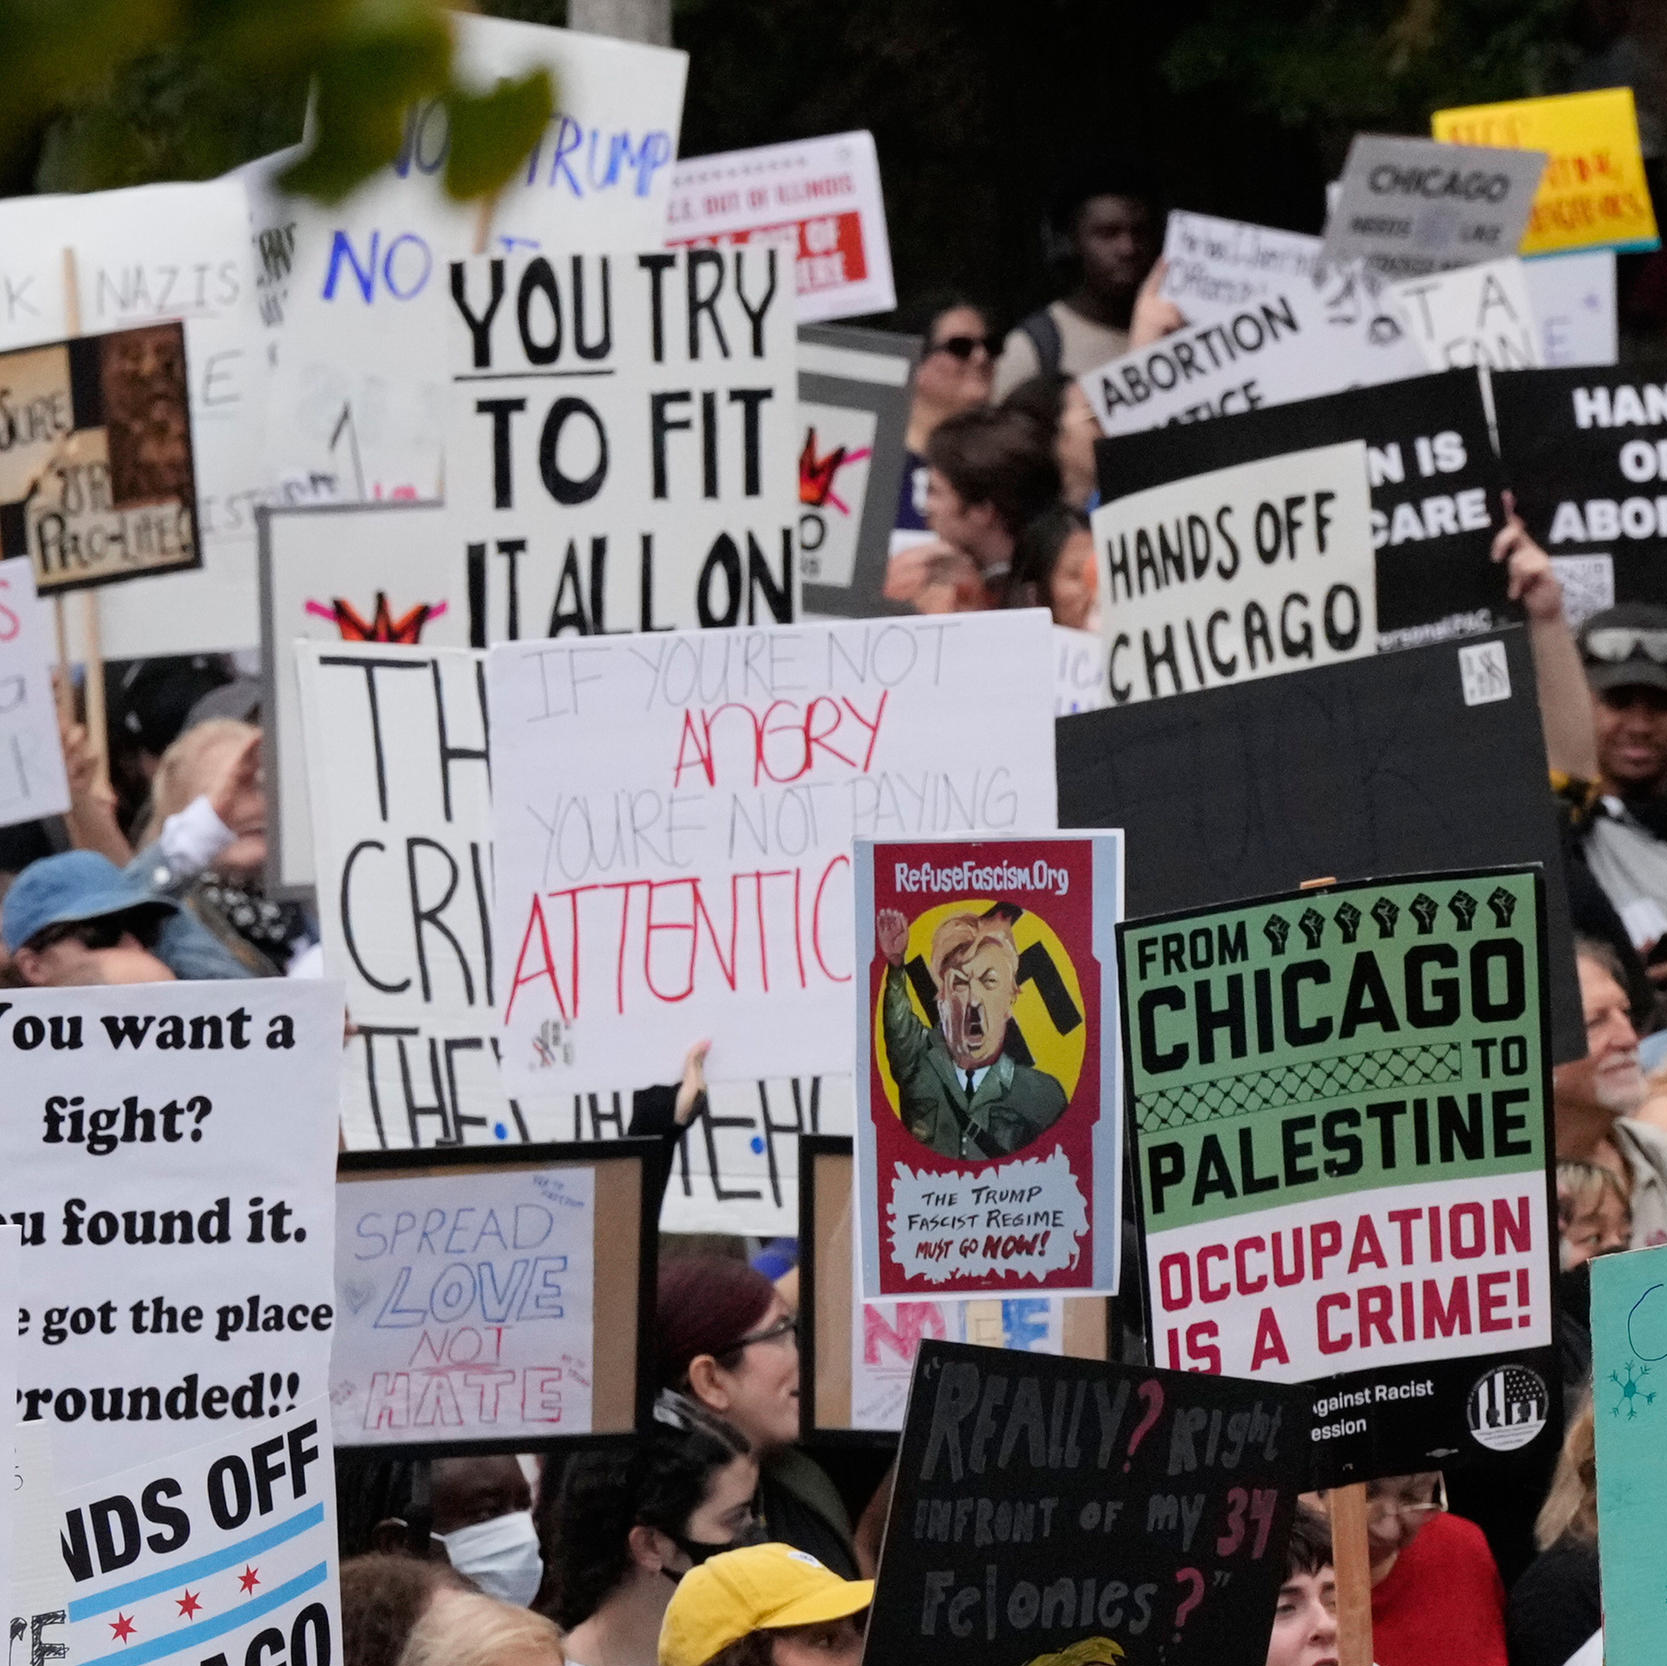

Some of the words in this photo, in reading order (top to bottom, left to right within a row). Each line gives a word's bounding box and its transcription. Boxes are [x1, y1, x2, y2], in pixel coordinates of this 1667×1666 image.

[322, 232, 430, 303] NO
[450, 254, 614, 368] YOU
[639, 248, 777, 363] TRY
[1101, 296, 1301, 418] ABORTION
[476, 398, 609, 508] TO
[650, 389, 773, 500] FIT
[1416, 432, 1467, 478] IS
[1108, 508, 1241, 602] HANDS
[1254, 492, 1336, 566] OFF
[467, 538, 527, 647] IT
[550, 535, 677, 642] ALL
[697, 528, 795, 630] ON
[524, 647, 611, 724] IF
[629, 632, 808, 713] YOU'RE
[828, 623, 961, 689] NOT
[1109, 583, 1364, 704] CHICAGO
[674, 690, 889, 787] ANGRY
[527, 797, 708, 884] YOU'RE
[729, 781, 836, 859] NOT
[1137, 922, 1249, 981] FROM
[103, 1006, 252, 1050] want
[267, 1015, 294, 1050] a
[1137, 937, 1525, 1076] CHICAGO
[1471, 1036, 1528, 1080] TO
[44, 1096, 212, 1155] fight?
[1149, 1087, 1533, 1214] PALESTINE
[63, 1195, 230, 1247] found
[249, 1197, 308, 1244] it.
[355, 1203, 553, 1260] SPREAD
[908, 1214, 980, 1232] FASCIST
[986, 1209, 1065, 1229] REGIME
[921, 1190, 959, 1207] THE
[972, 1185, 1043, 1206] TRUMP
[915, 1240, 953, 1262] MUST
[959, 1238, 978, 1258] GO
[982, 1231, 1051, 1260] NOW!
[1158, 1196, 1533, 1312] OCCUPATION
[43, 1304, 117, 1345] got
[130, 1293, 205, 1334] the
[217, 1295, 333, 1347] place
[373, 1255, 568, 1329] LOVE
[1250, 1306, 1289, 1372] A
[1317, 1268, 1533, 1356] CRIME!
[409, 1326, 513, 1367] NOT
[363, 1366, 563, 1430] HATE
[1374, 1379, 1435, 1403] Racist
[207, 1419, 320, 1537] OFF
[1216, 1486, 1278, 1559] 34
